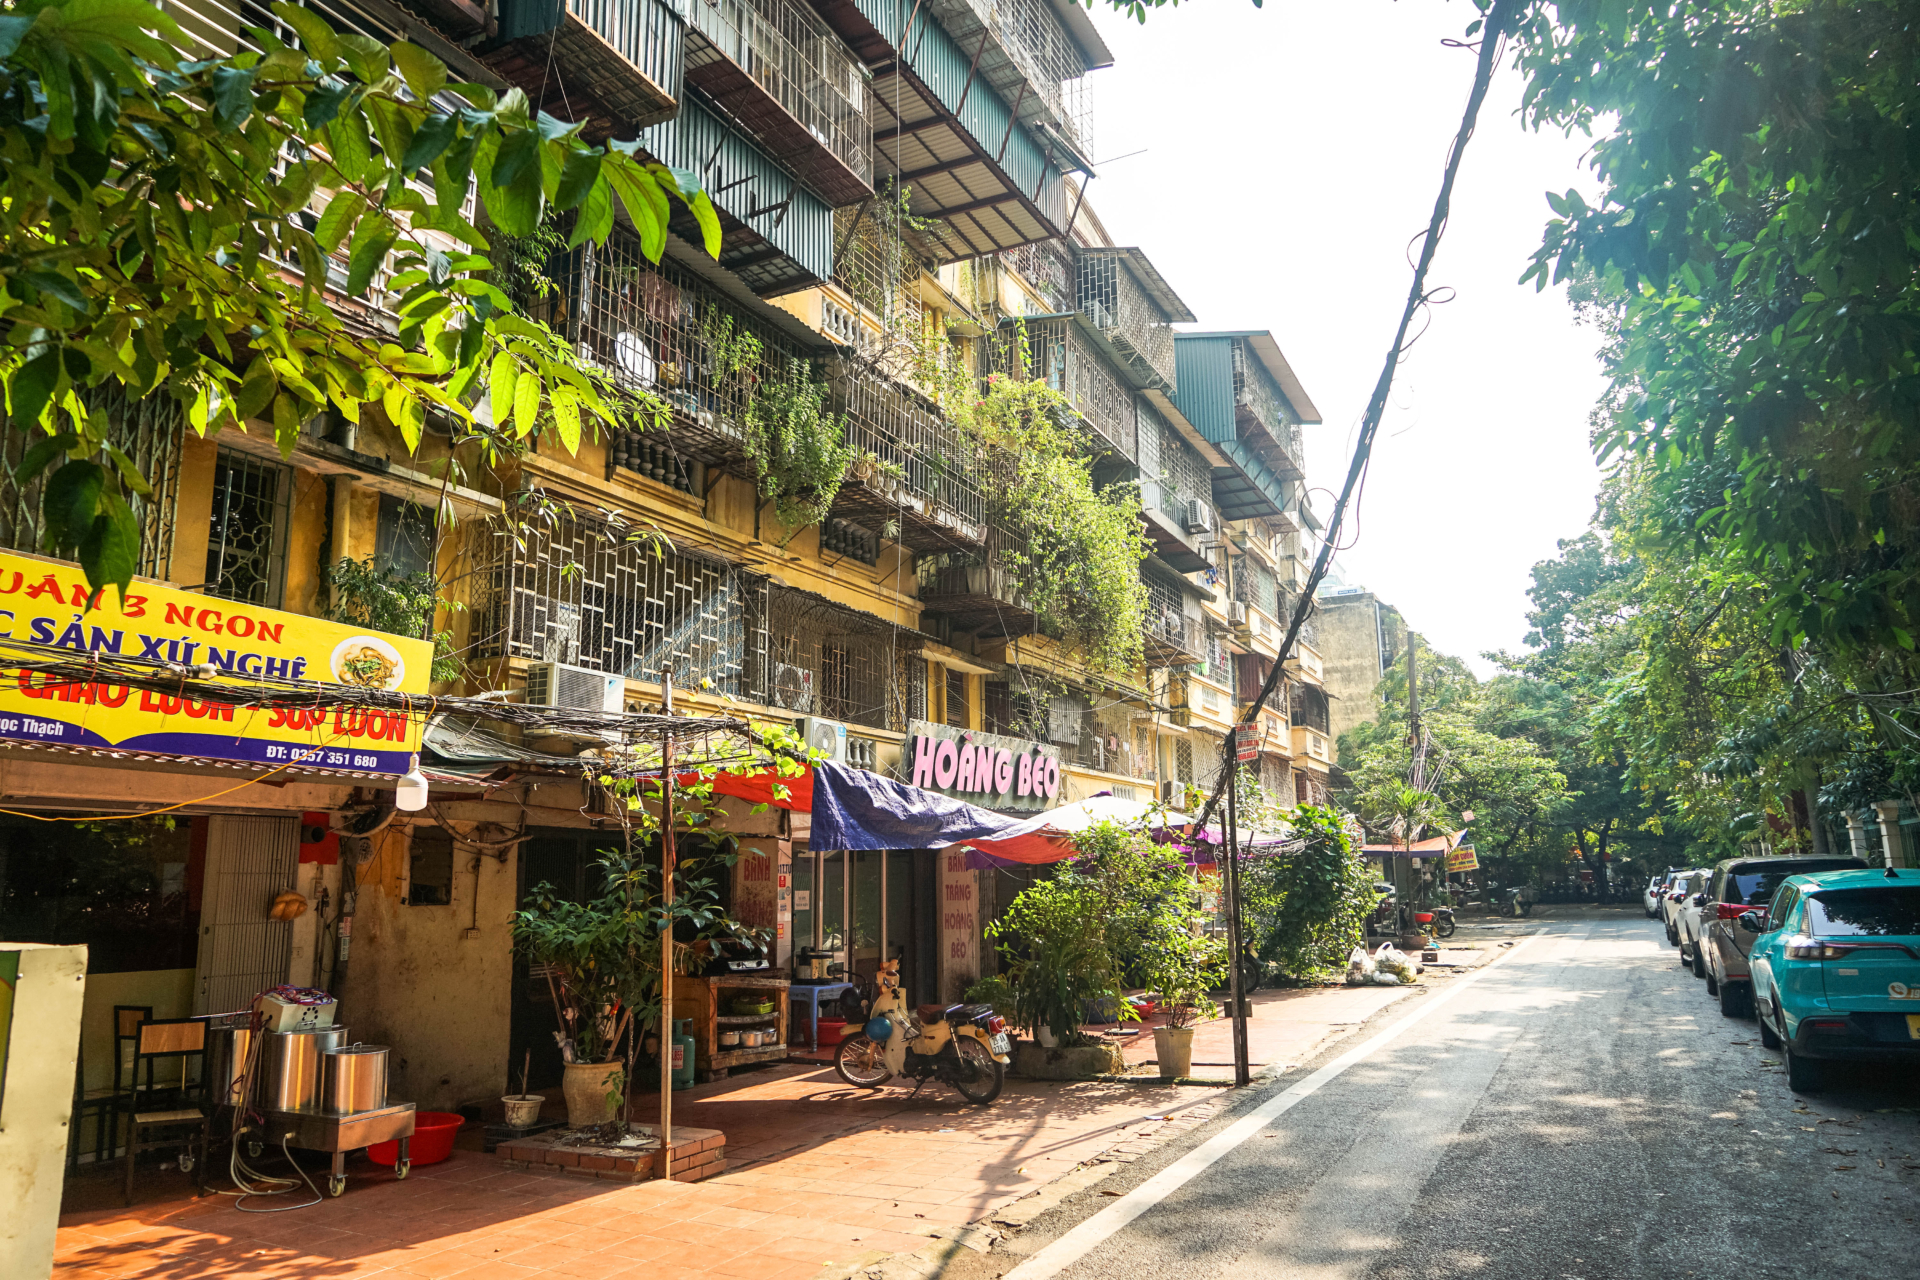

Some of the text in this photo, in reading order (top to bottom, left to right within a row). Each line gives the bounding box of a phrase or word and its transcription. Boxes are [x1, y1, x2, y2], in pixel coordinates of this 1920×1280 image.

[122, 594, 148, 618] 3
[164, 602, 285, 644] NGON
[30, 614, 125, 653] SẢN
[23, 718, 64, 737] Thạch
[266, 745, 378, 768] ĐT: 0357 351 680
[912, 732, 1061, 799] HOÀNG BÈO
[945, 880, 972, 901] TRÁNG
[944, 909, 972, 930] HOÀNG
[951, 938, 967, 959] BÈO
